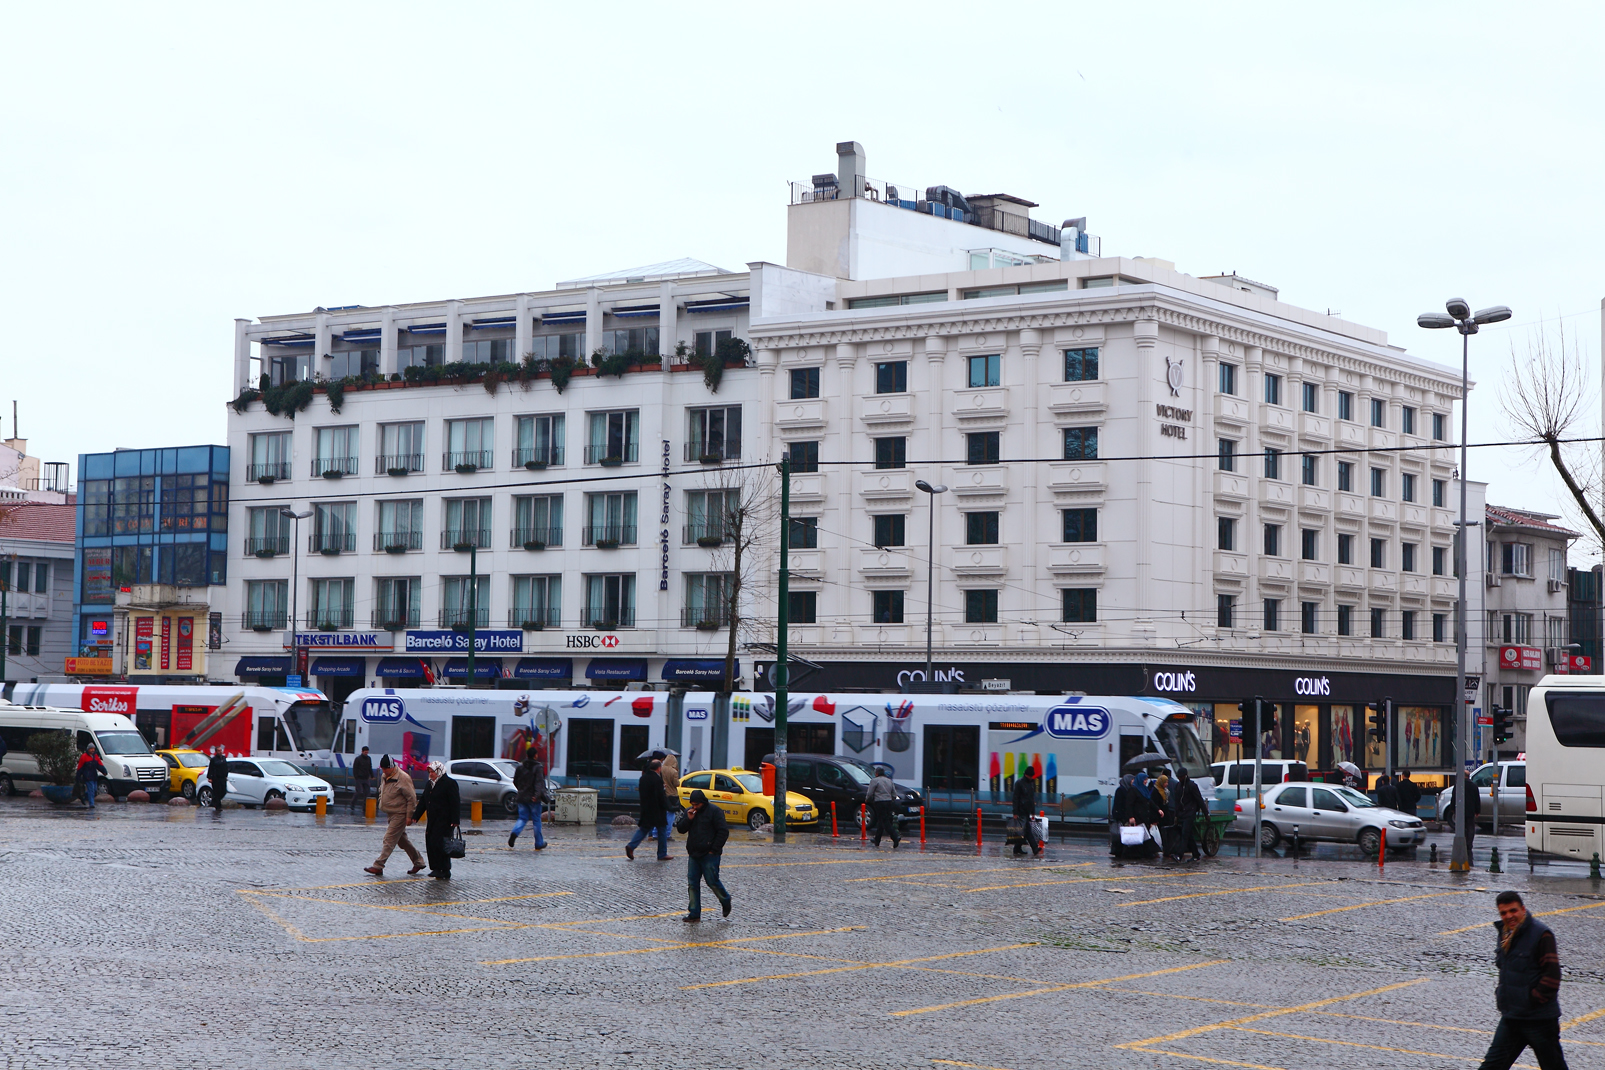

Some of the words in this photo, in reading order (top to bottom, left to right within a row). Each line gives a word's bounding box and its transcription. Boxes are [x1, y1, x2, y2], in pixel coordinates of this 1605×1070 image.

[1156, 404, 1193, 422] VICTORY
[1161, 422, 1188, 440] HOTEL
[661, 439, 671, 478] Hotel
[661, 482, 672, 524] Saray
[660, 528, 669, 591] Barceló
[407, 635, 453, 649] Barceló
[456, 636, 488, 651] Saay
[491, 635, 521, 648] Hotel
[566, 635, 600, 649] HSBC
[897, 667, 965, 688] COIN'S
[1155, 671, 1196, 692] COLIN'S
[1295, 675, 1331, 696] COLIN'S
[89, 697, 129, 712] Scrikss
[366, 702, 400, 718] MAS
[938, 702, 984, 713] masaüstü
[689, 711, 706, 719] MAS
[1054, 713, 1103, 732] MAS
